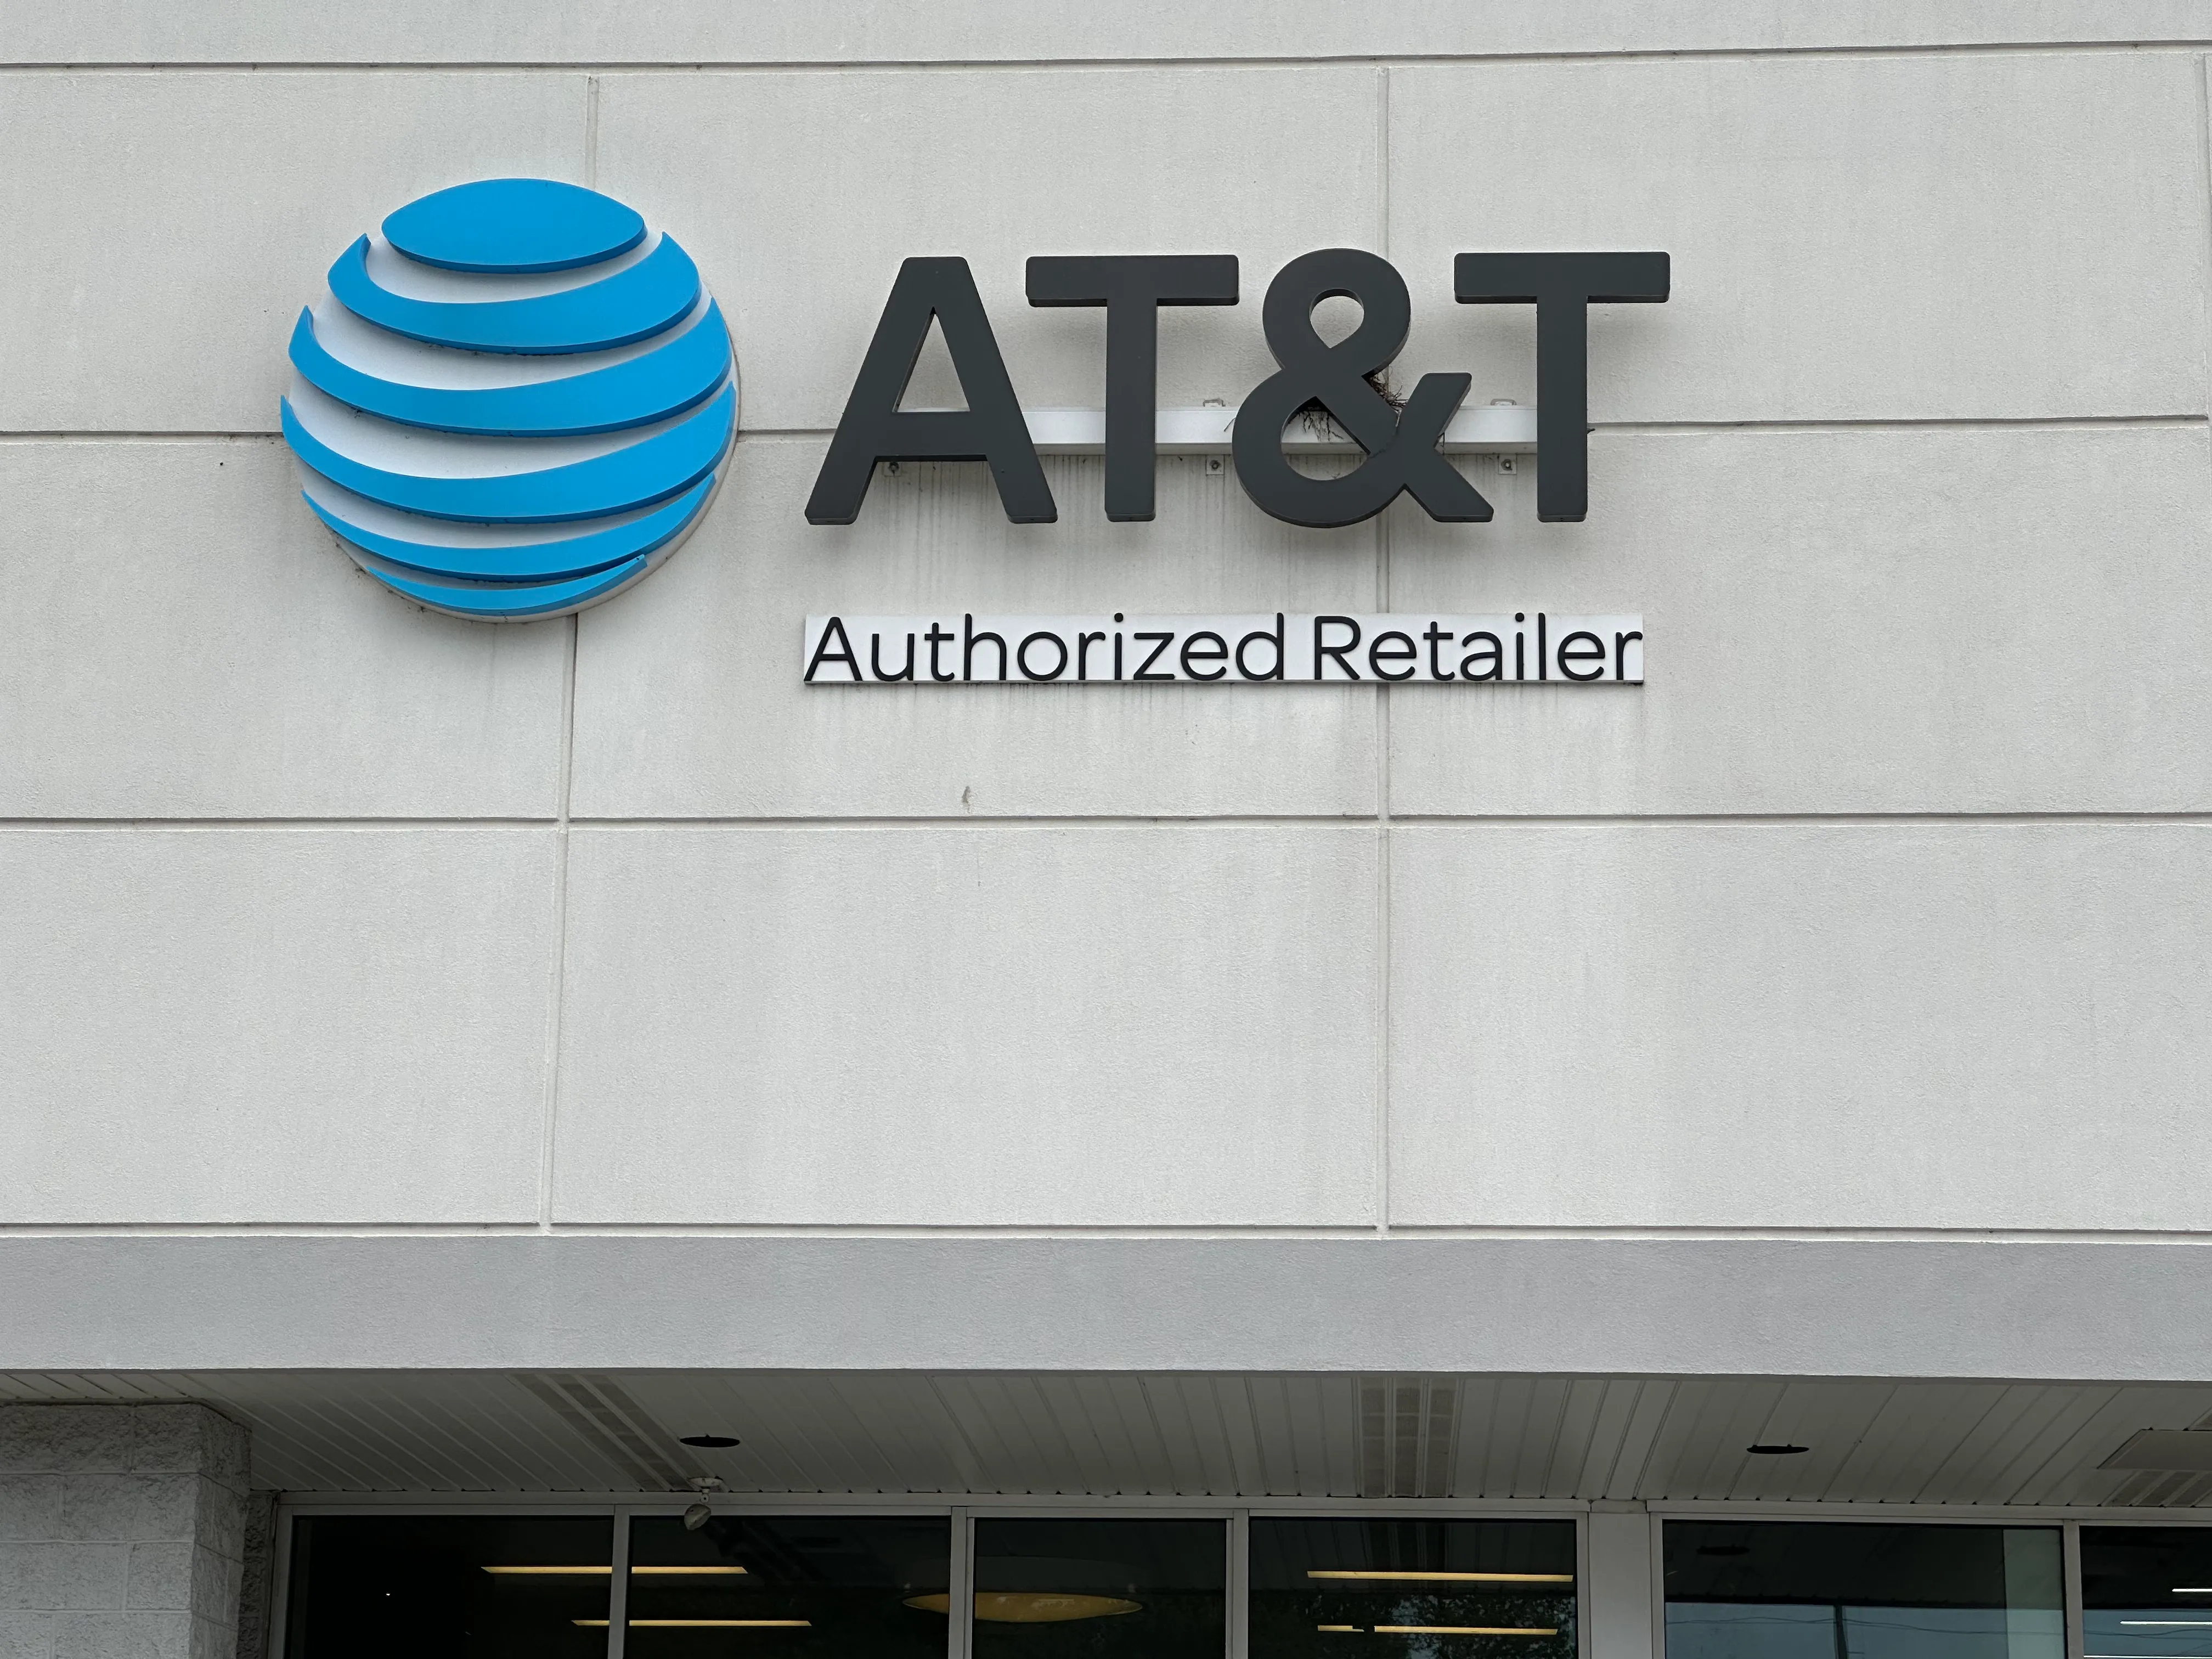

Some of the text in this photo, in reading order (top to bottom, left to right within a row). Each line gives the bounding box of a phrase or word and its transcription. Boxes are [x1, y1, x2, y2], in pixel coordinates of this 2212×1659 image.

[805, 249, 1671, 526] AT&T
[804, 612, 1644, 682] Authorized Retailer
